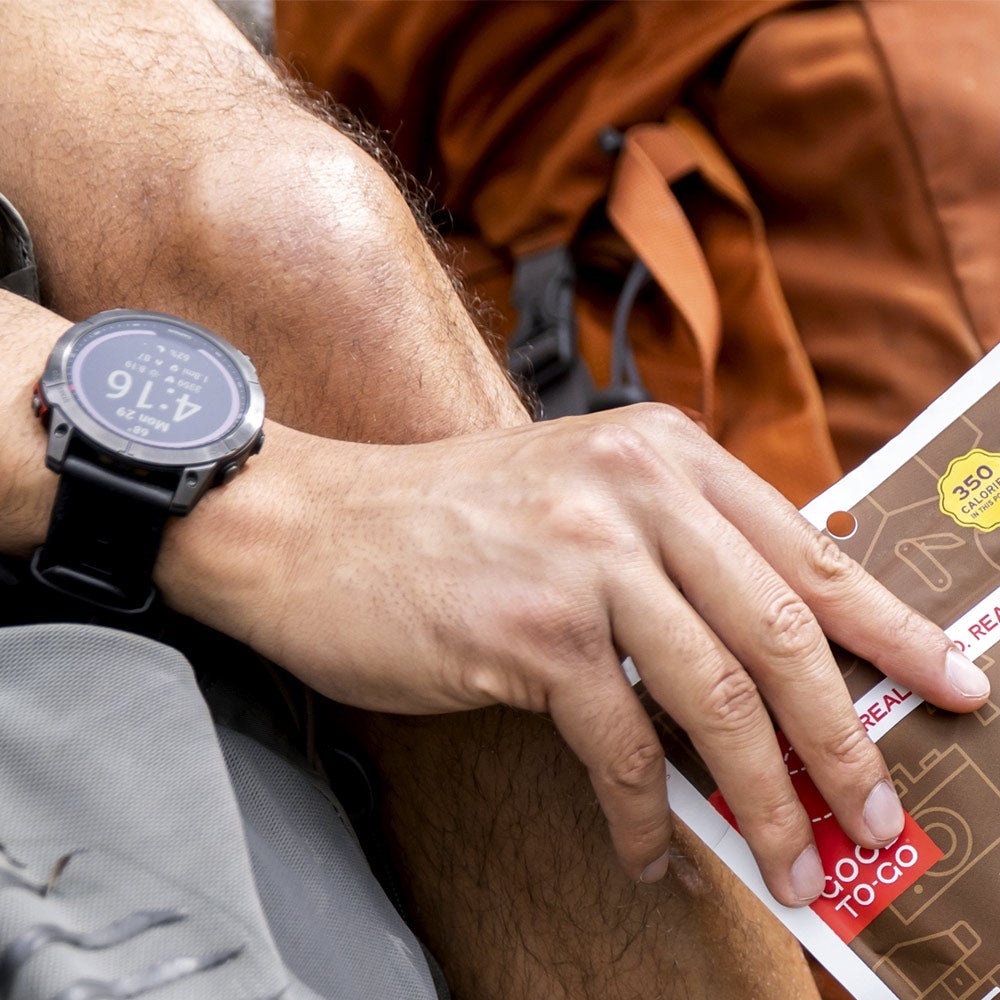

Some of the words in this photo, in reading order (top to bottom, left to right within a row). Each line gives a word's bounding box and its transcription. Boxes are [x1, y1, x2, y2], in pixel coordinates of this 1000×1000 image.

[105, 369, 202, 422] 4:16
[116, 407, 136, 420] 29
[139, 413, 170, 432] Mon
[952, 465, 993, 500] 350
[971, 509, 979, 519] IN
[978, 499, 995, 514] THIS
[859, 688, 912, 732] REAL
[821, 837, 899, 899] GOO
[834, 844, 919, 918] TO-GO
